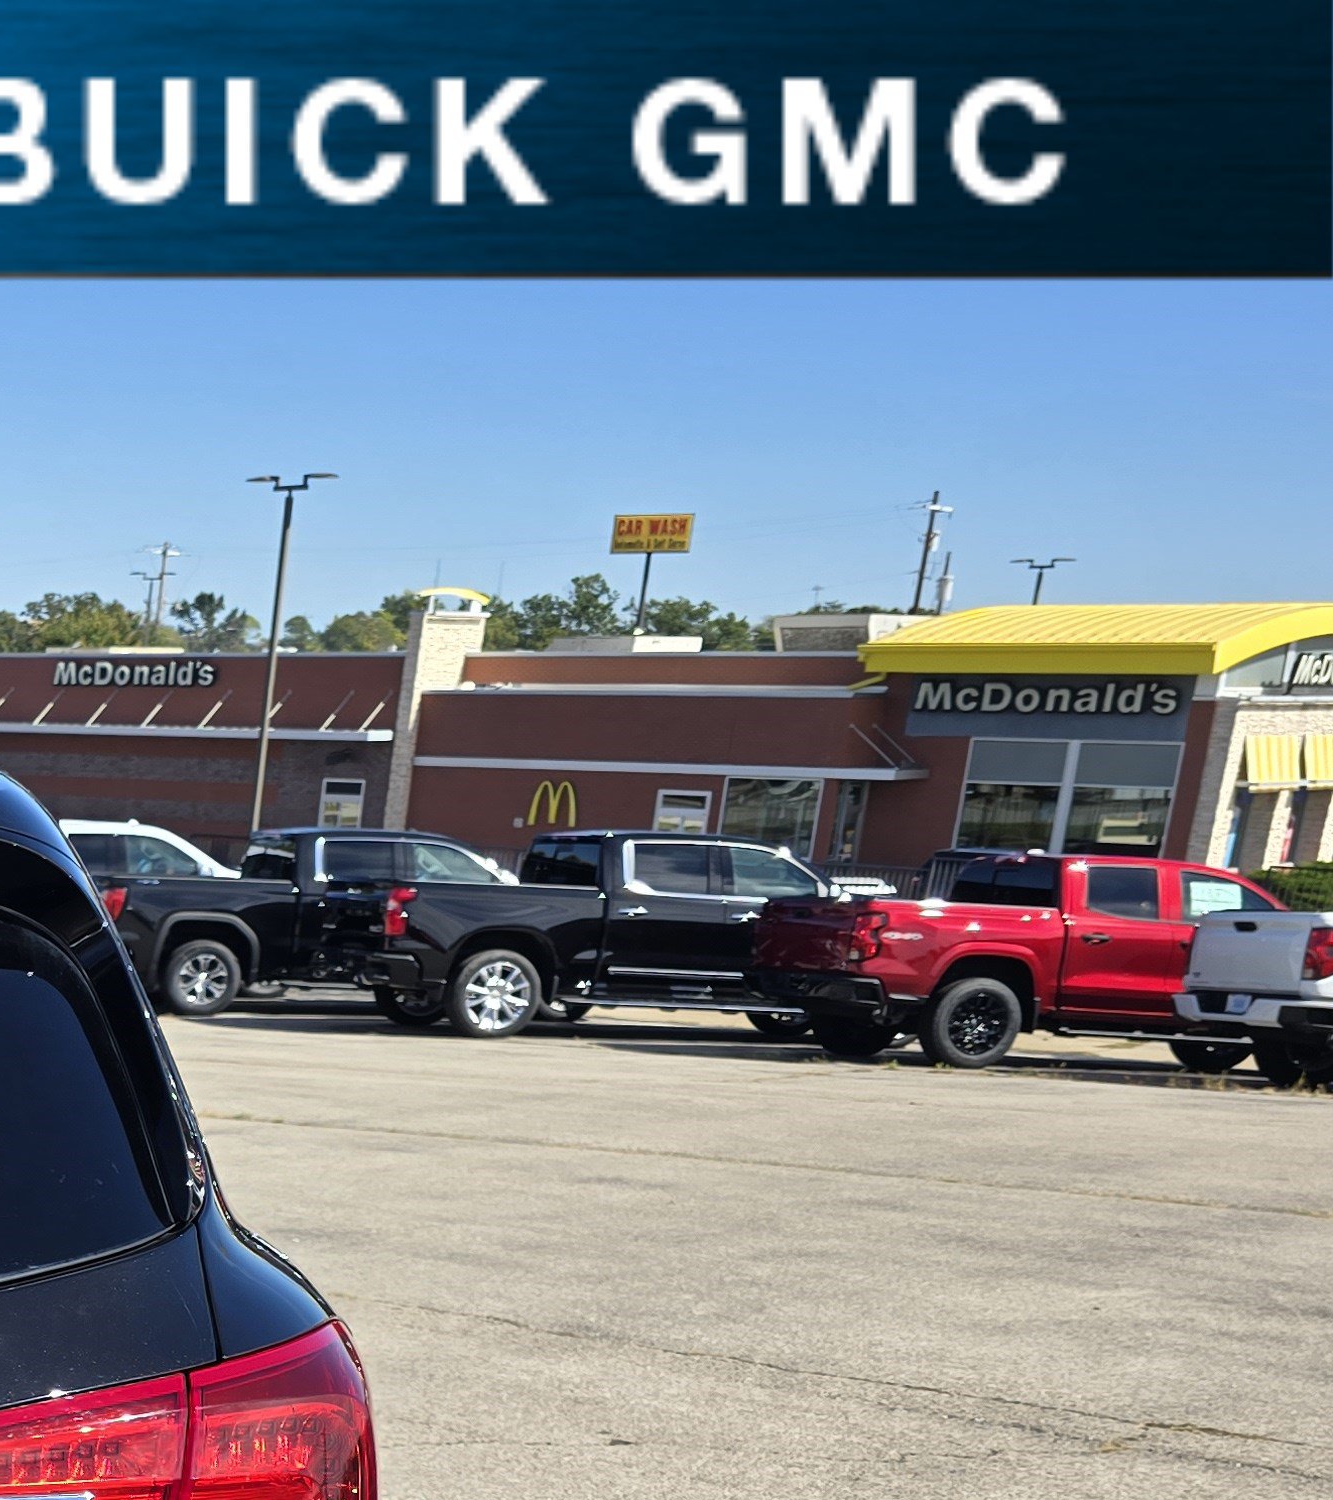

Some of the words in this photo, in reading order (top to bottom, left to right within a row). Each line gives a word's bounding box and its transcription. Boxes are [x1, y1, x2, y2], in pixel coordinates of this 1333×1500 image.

[618, 519, 644, 536] CAR
[648, 517, 688, 535] WASH
[53, 660, 215, 686] McDonald's
[1292, 653, 1333, 686] McD
[913, 682, 1178, 714] McDonald's
